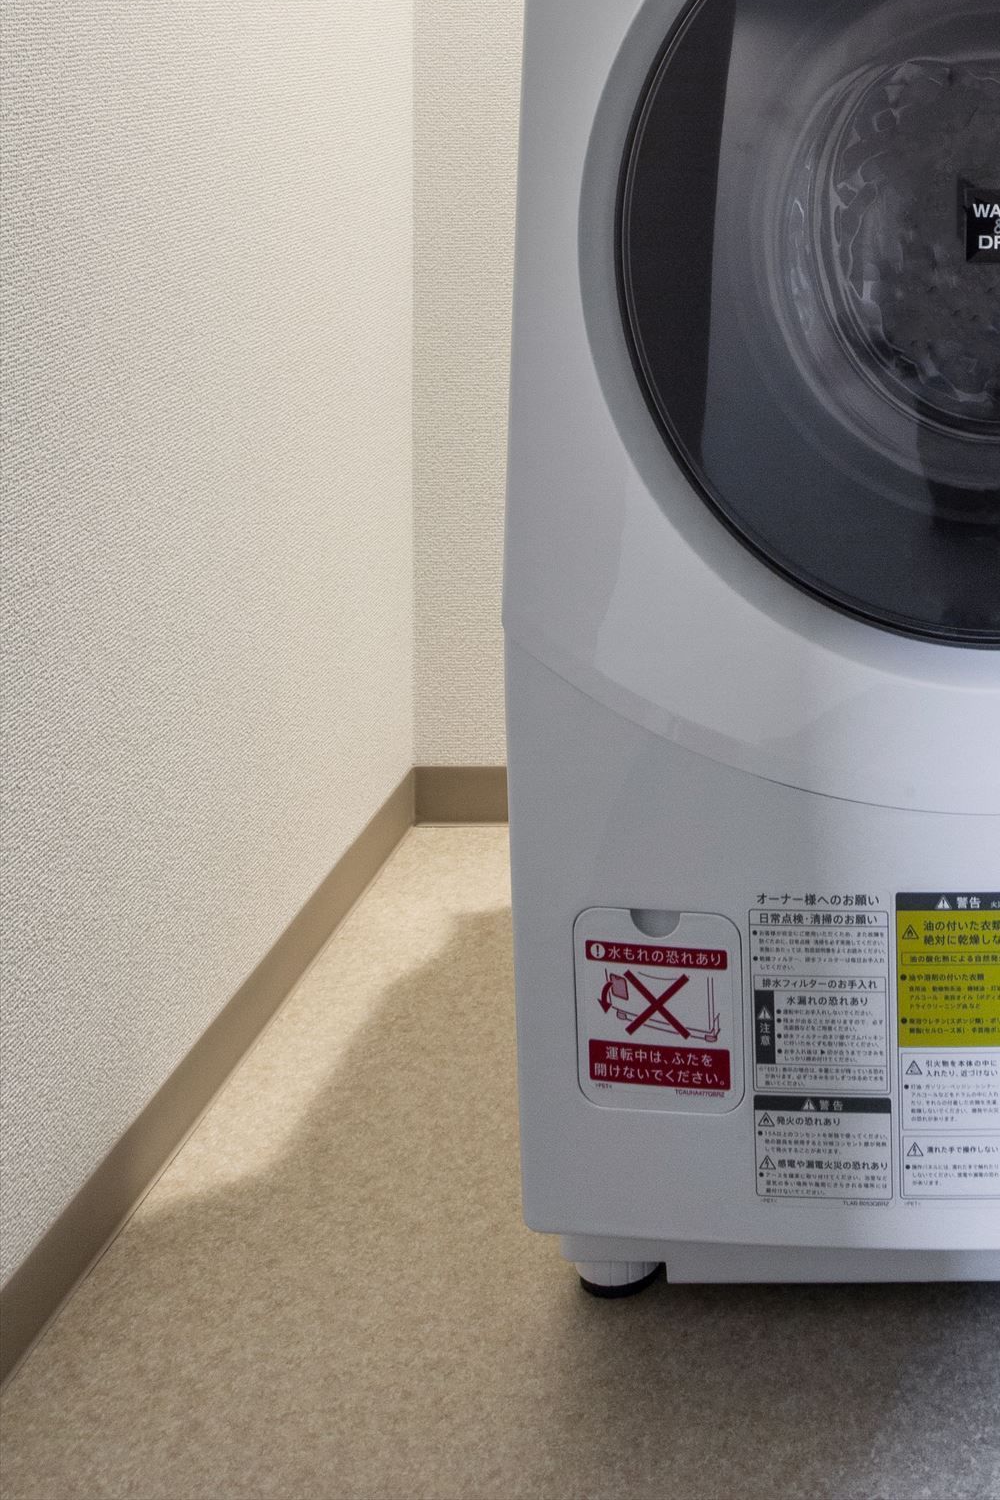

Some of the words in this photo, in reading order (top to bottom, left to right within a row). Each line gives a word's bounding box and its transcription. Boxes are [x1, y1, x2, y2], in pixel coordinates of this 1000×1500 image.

[757, 893, 879, 905] オーナー様へのお願い
[956, 897, 981, 909] 警告
[760, 913, 877, 924] 日常点検・清掃のお願い
[608, 947, 721, 965] 水もれの恐れあり
[762, 979, 877, 989] 排水フィルターのお手入れ
[787, 996, 868, 1006] 水漏れの恐れあり
[760, 1023, 770, 1045] 注意
[606, 1047, 712, 1067] 運転中は、ふたを
[594, 1064, 725, 1085] 開けないでください。
[819, 1100, 843, 1110] 警告
[777, 1116, 840, 1126] 発火の恐れあり
[778, 1160, 888, 1170] 感電や漏電火災の恐れあり
